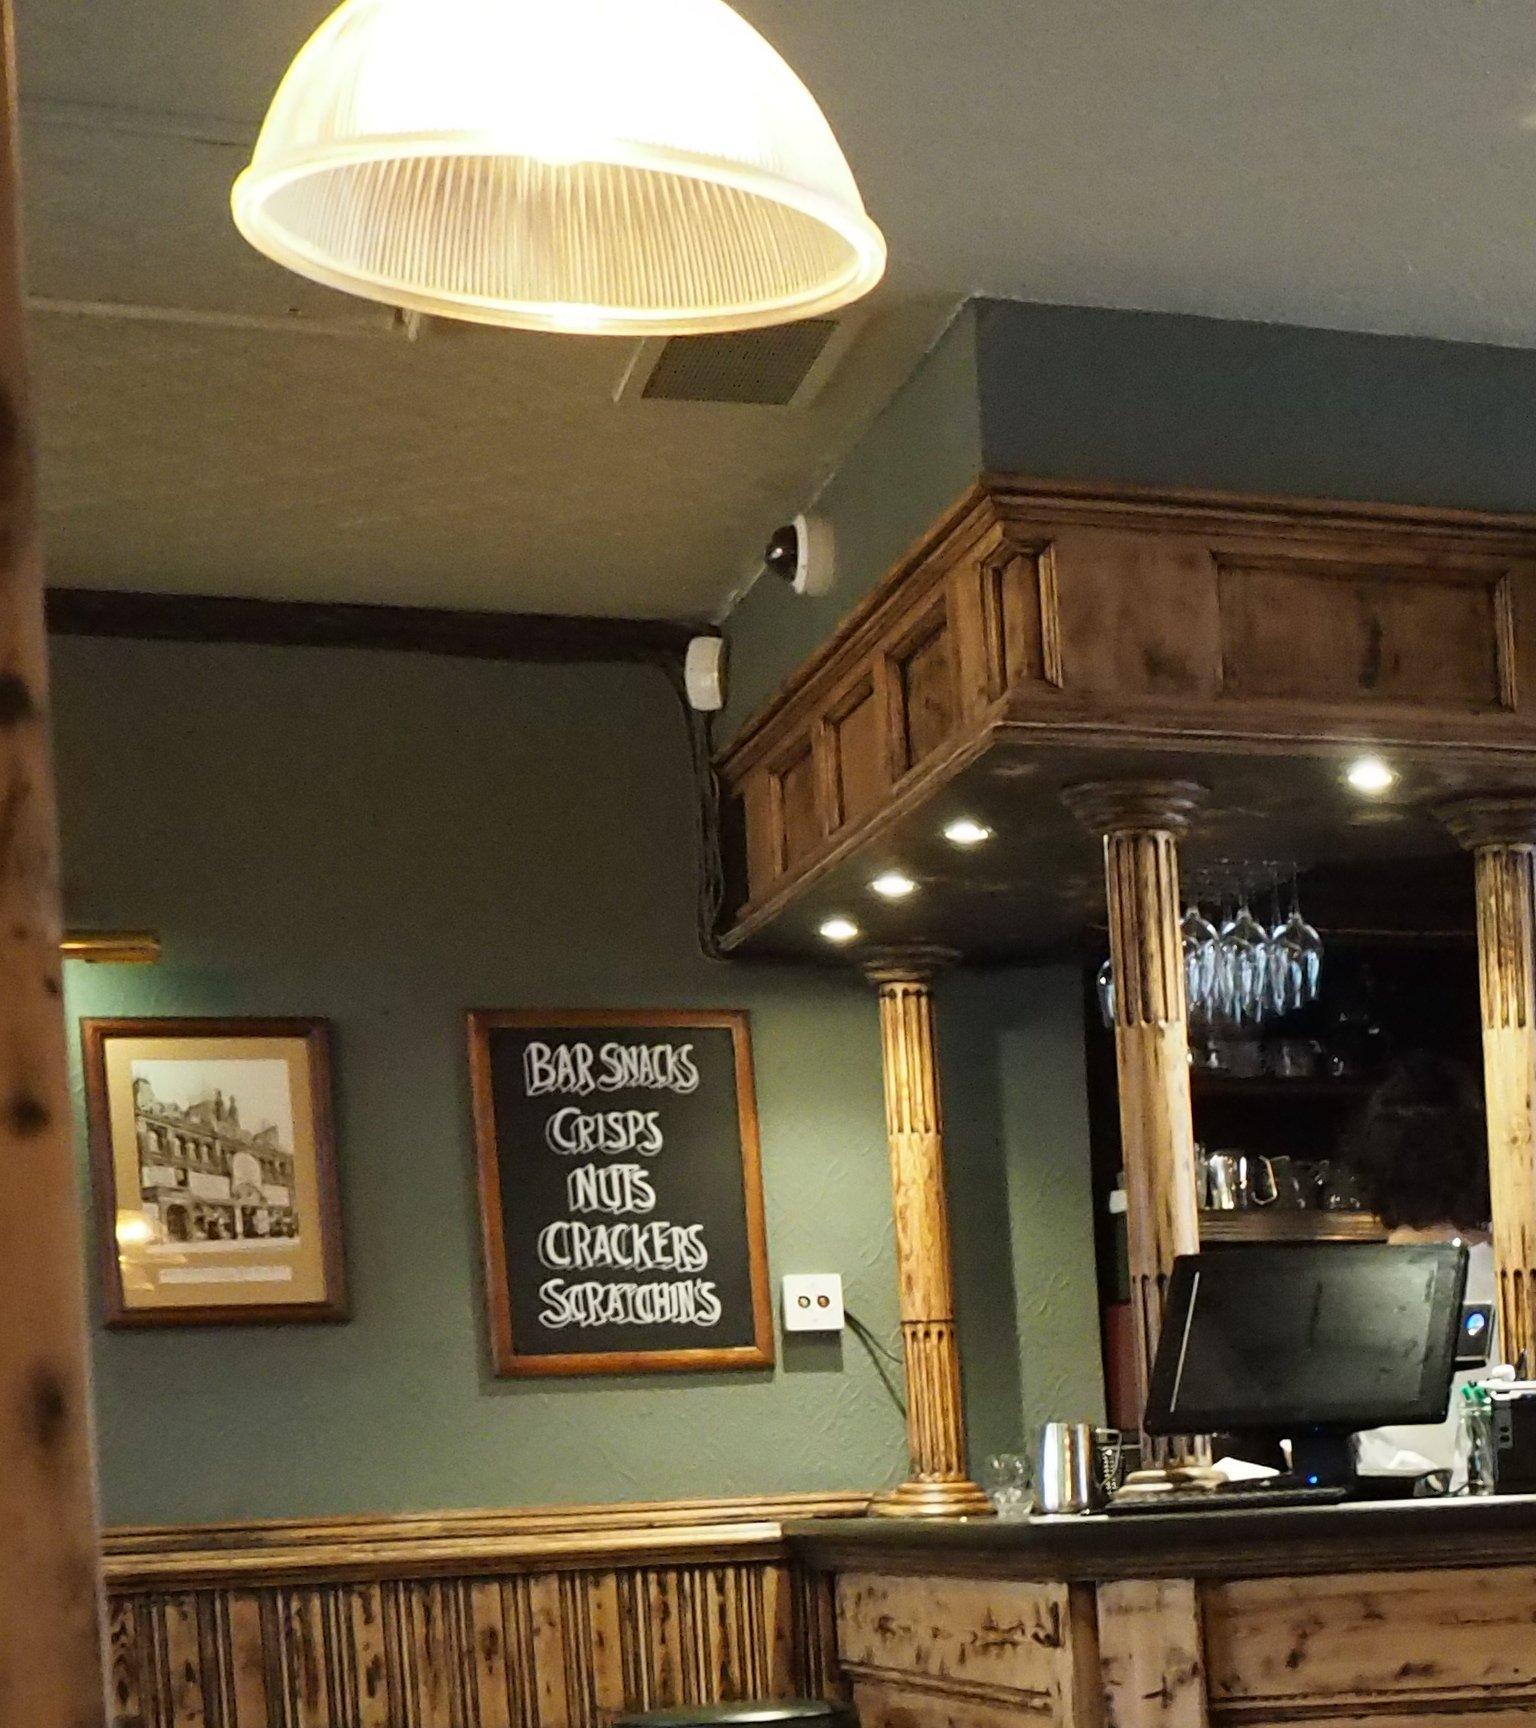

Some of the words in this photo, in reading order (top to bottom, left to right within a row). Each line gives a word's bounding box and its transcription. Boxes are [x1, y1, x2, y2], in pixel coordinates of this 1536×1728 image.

[522, 1041, 595, 1097] BAR
[597, 1041, 699, 1094] SNACKS
[545, 1107, 663, 1156] CRISPS
[567, 1163, 657, 1215] NUTS
[538, 1221, 708, 1272] CRACKERS
